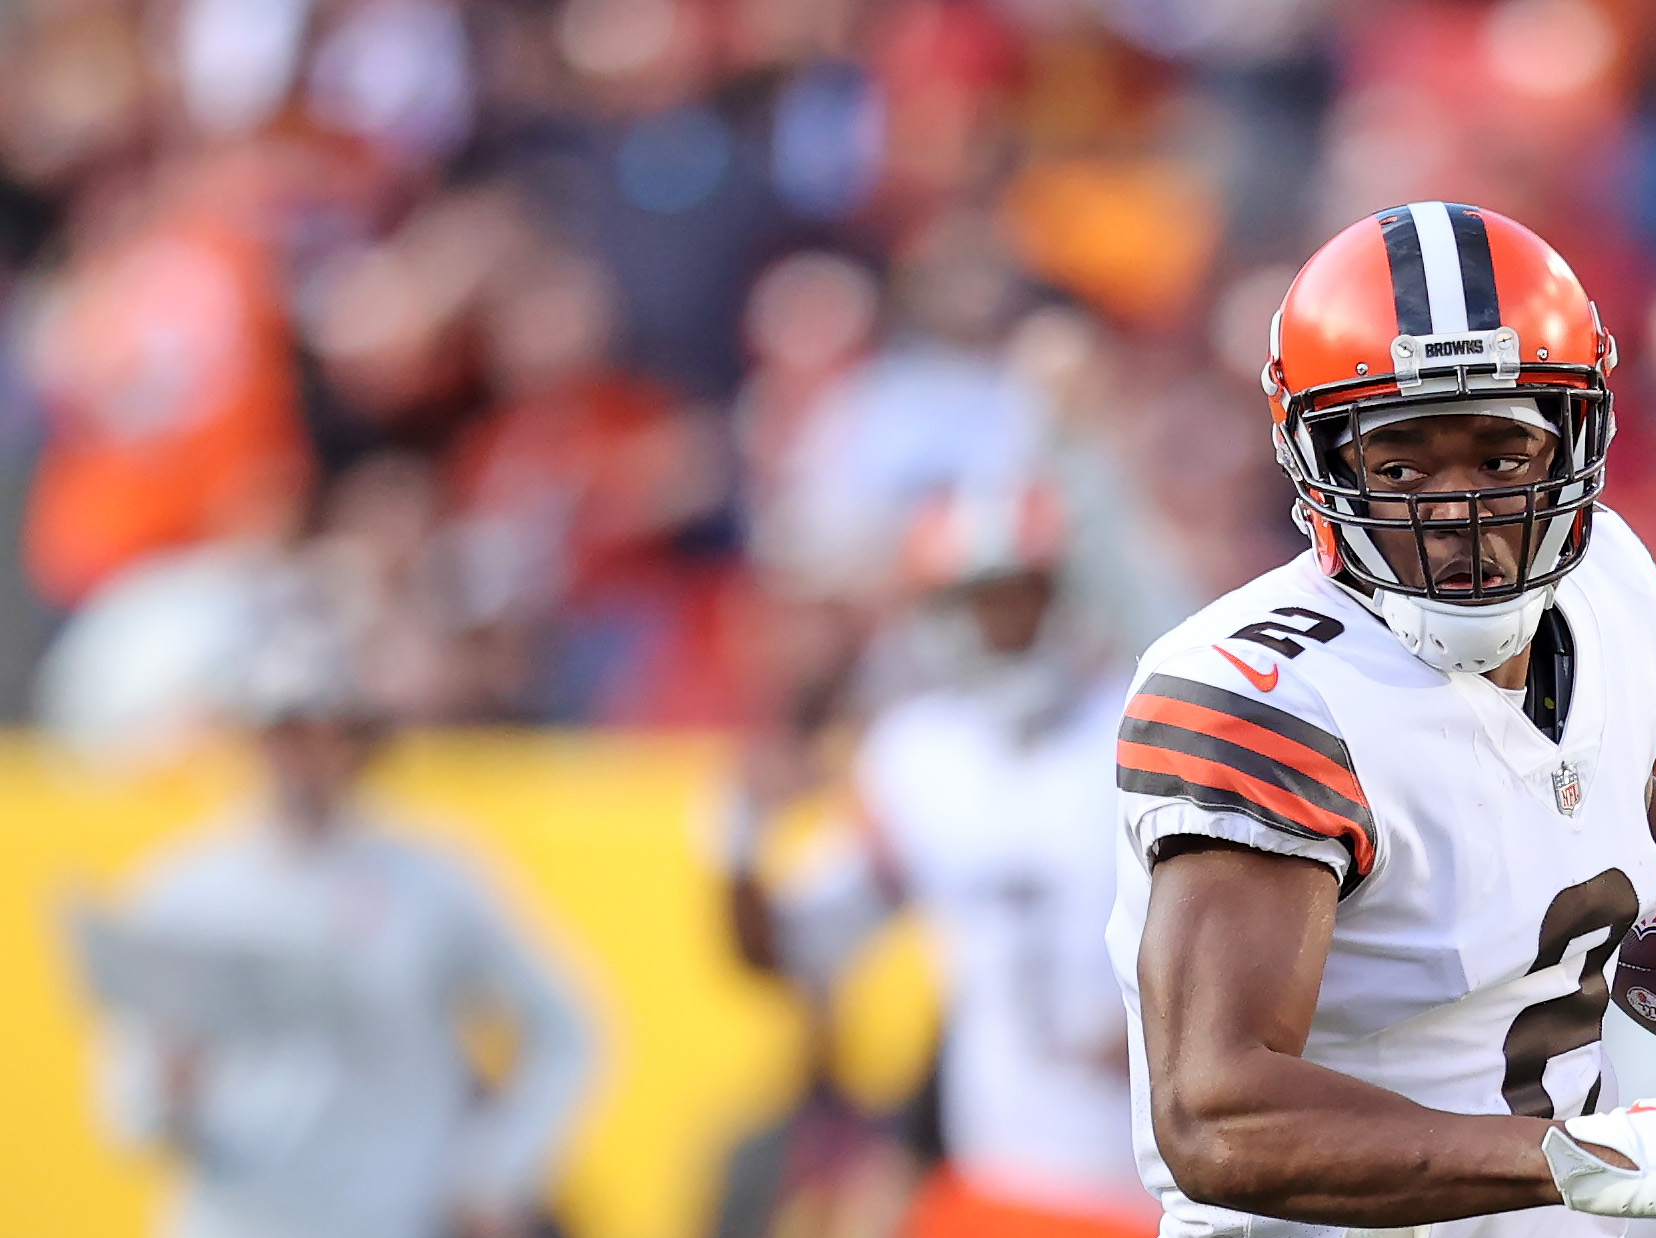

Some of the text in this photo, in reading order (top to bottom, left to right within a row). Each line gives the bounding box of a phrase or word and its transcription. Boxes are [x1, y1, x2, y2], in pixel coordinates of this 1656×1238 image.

[1425, 339, 1484, 359] BROWNS
[1225, 606, 1345, 660] 2
[1561, 784, 1581, 807] NFL
[1501, 867, 1640, 1120] 2
